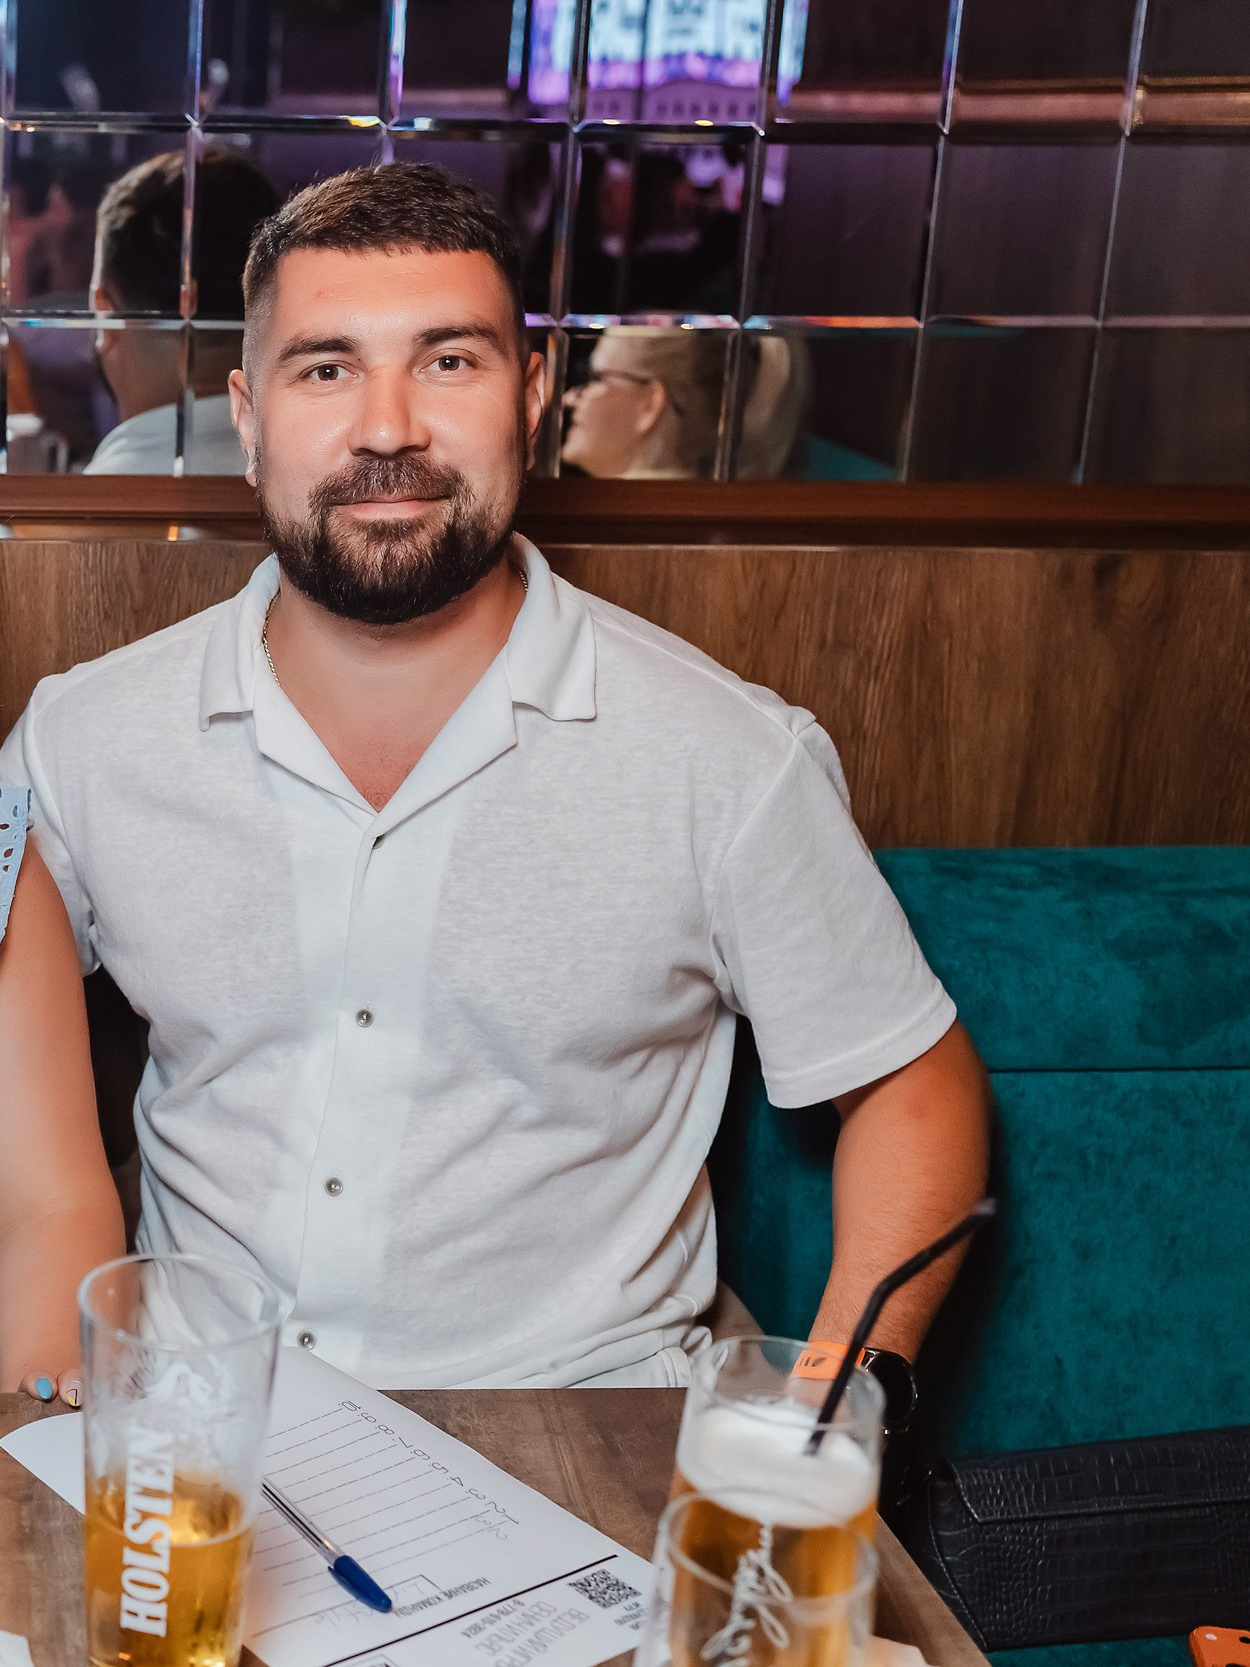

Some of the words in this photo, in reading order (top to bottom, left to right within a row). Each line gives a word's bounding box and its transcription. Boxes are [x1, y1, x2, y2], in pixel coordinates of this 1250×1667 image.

[119, 1421, 175, 1638] HOLSTEN
[442, 1576, 492, 1600] НАЗВАНИЕ
[523, 1607, 590, 1653] ВЕДУЩИЙ
